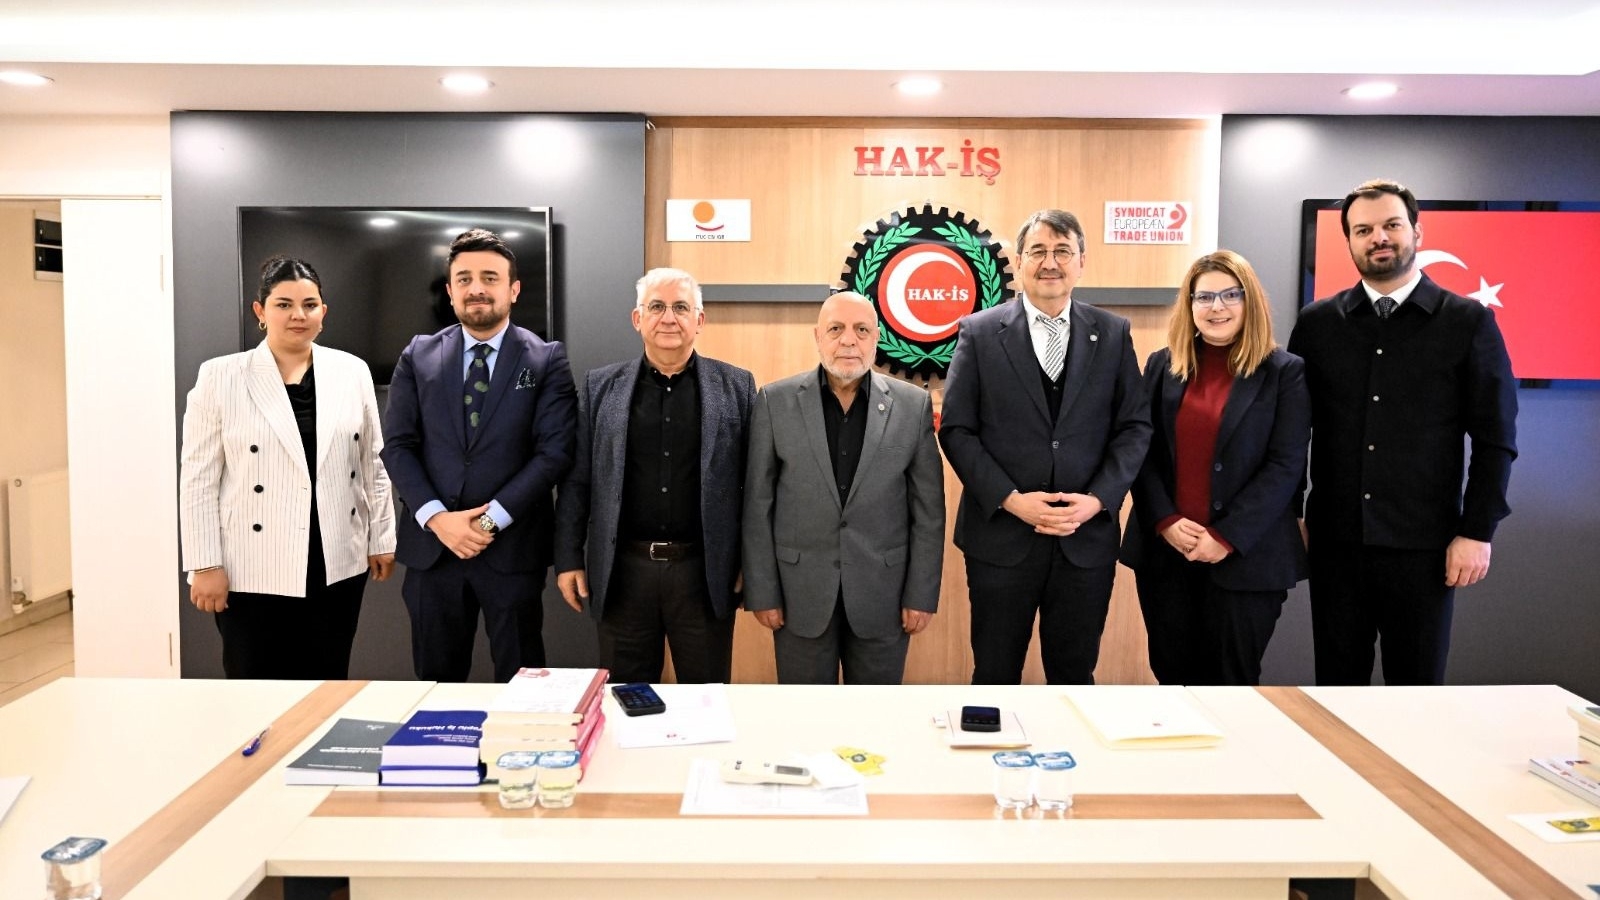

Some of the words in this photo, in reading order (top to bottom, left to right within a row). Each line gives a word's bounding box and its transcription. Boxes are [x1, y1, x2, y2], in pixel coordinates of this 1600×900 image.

[854, 139, 1001, 185] HAK-İŞ
[1114, 207, 1166, 218] SYNDICAT
[1113, 231, 1147, 241] TRADE
[1150, 231, 1184, 241] UNION
[907, 286, 969, 301] HAK-İŞ
